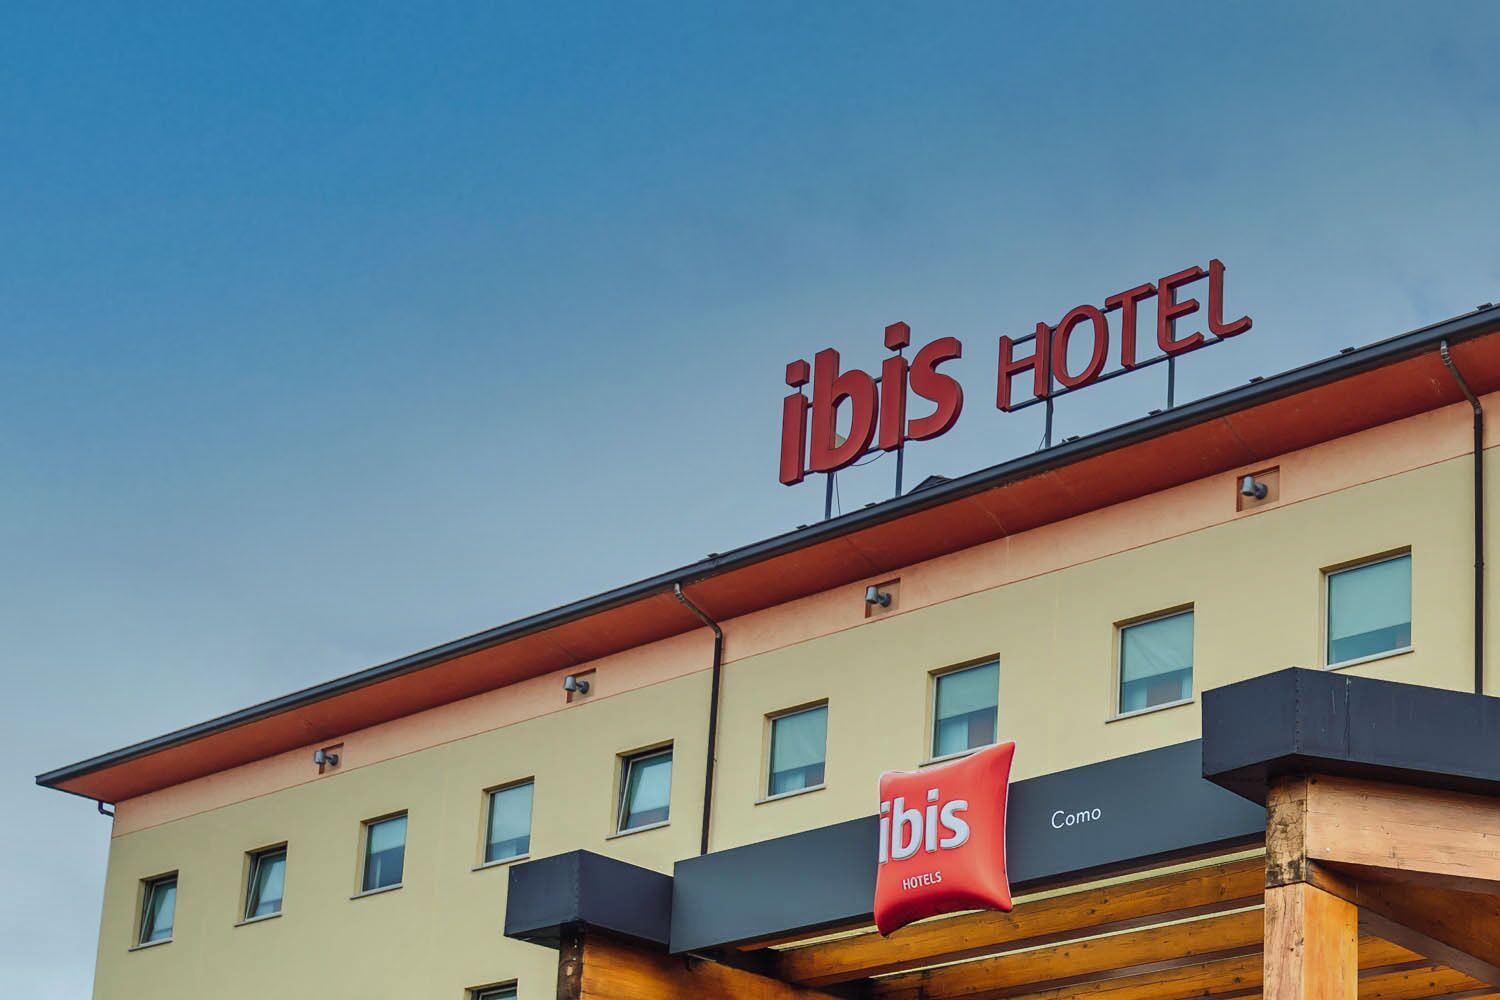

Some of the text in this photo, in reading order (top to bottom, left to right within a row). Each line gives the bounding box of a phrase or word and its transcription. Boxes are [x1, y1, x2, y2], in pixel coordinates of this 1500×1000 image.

[779, 258, 1253, 486] ibis HOTEL
[878, 789, 970, 865] ibis
[1051, 806, 1101, 829] Como
[903, 871, 942, 890] HOTELS
